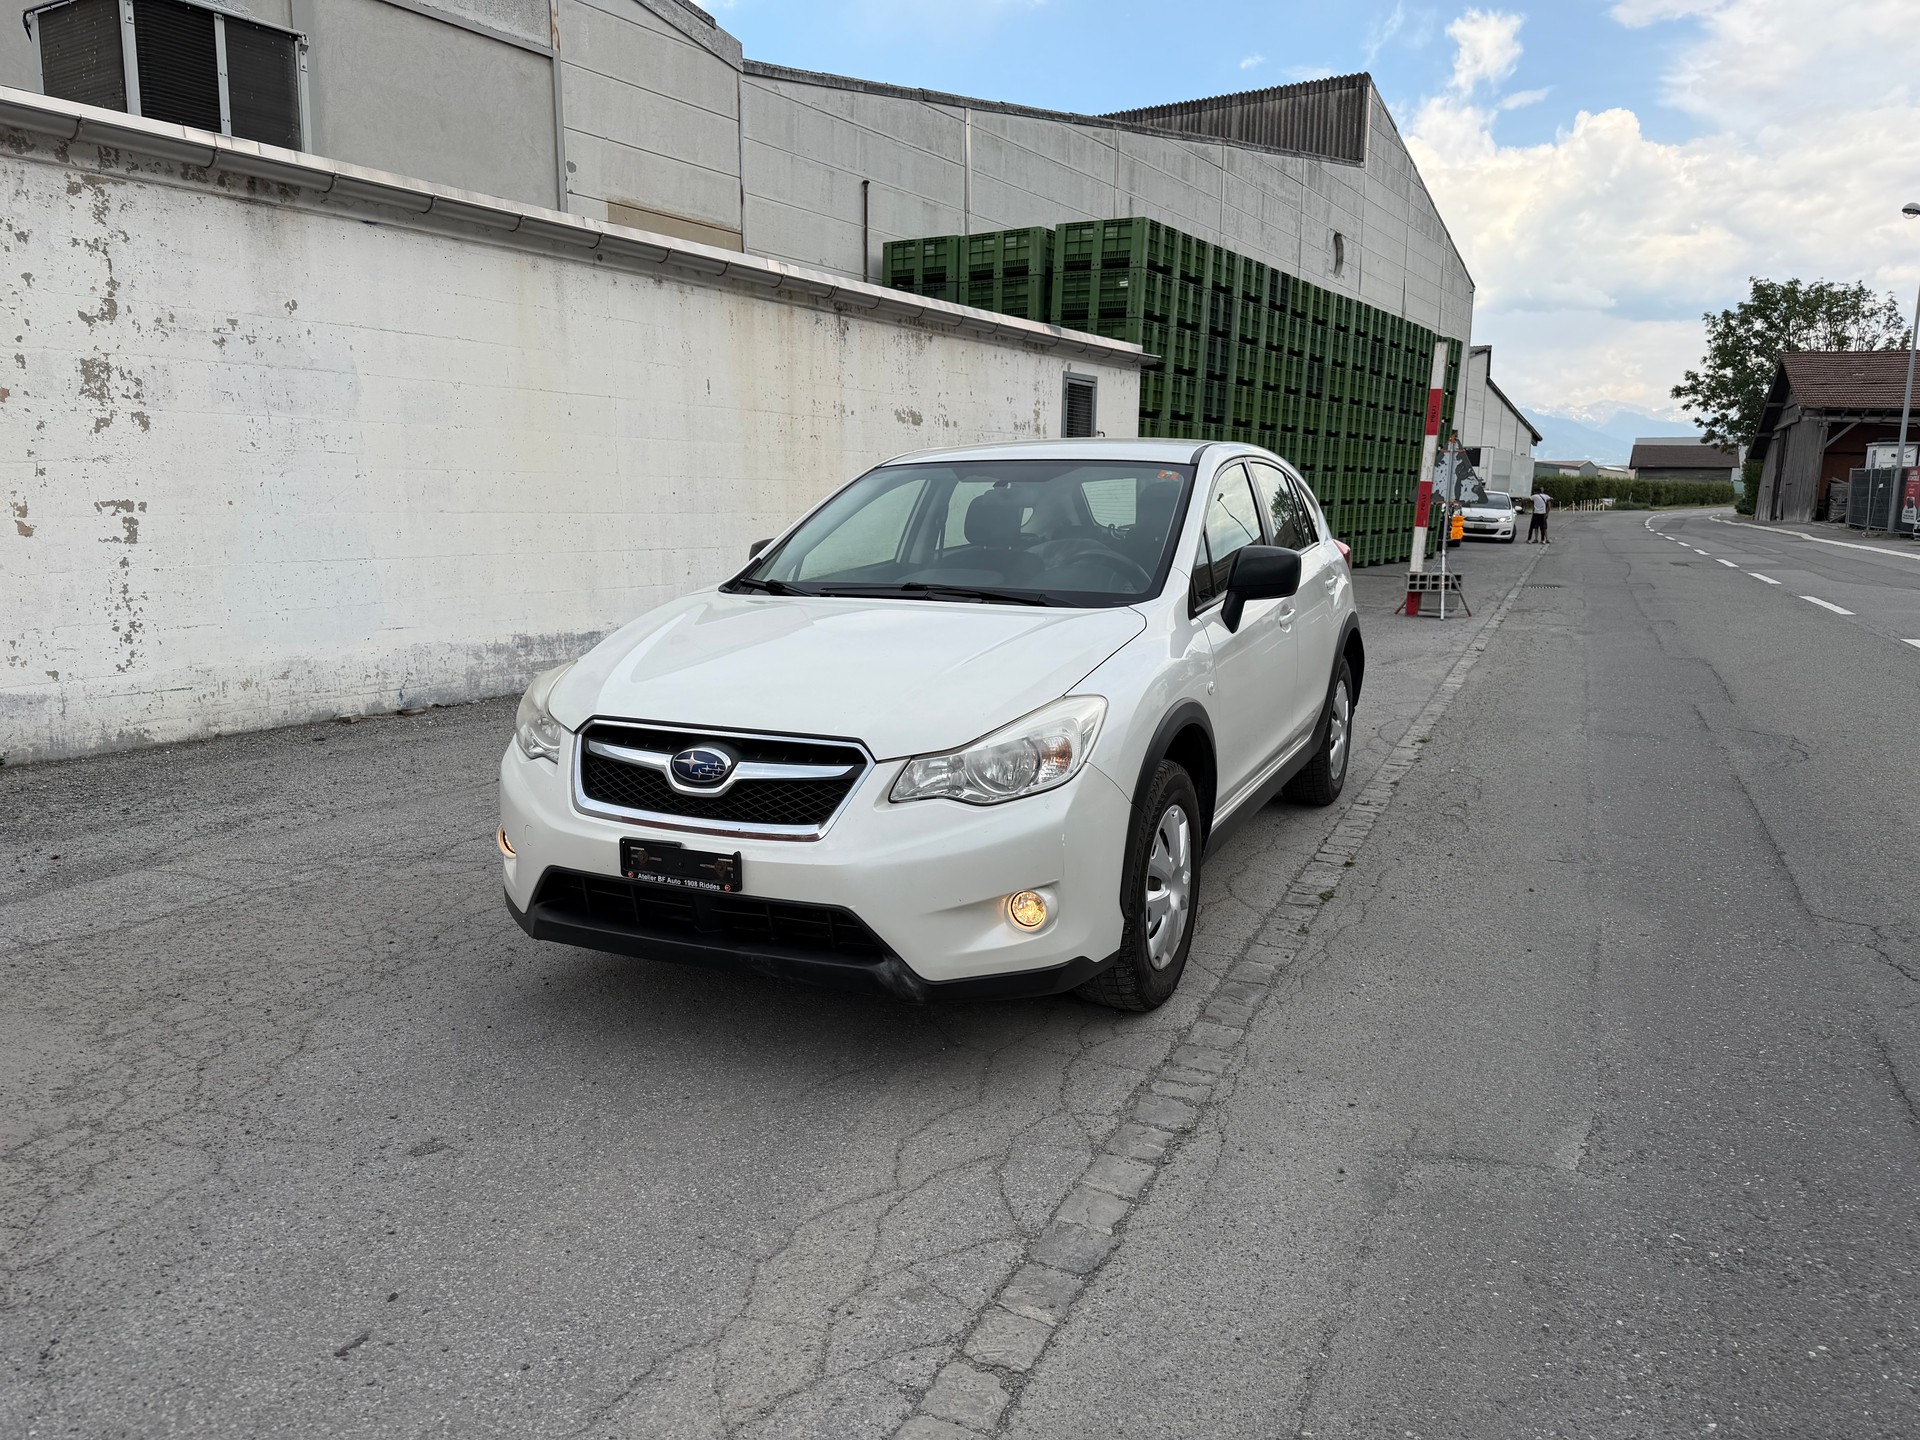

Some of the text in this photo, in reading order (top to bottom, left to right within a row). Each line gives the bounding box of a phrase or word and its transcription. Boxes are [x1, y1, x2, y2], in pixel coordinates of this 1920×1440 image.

[638, 873, 656, 881] Atelier
[667, 877, 681, 885] Auto
[699, 881, 720, 890] Riddes
